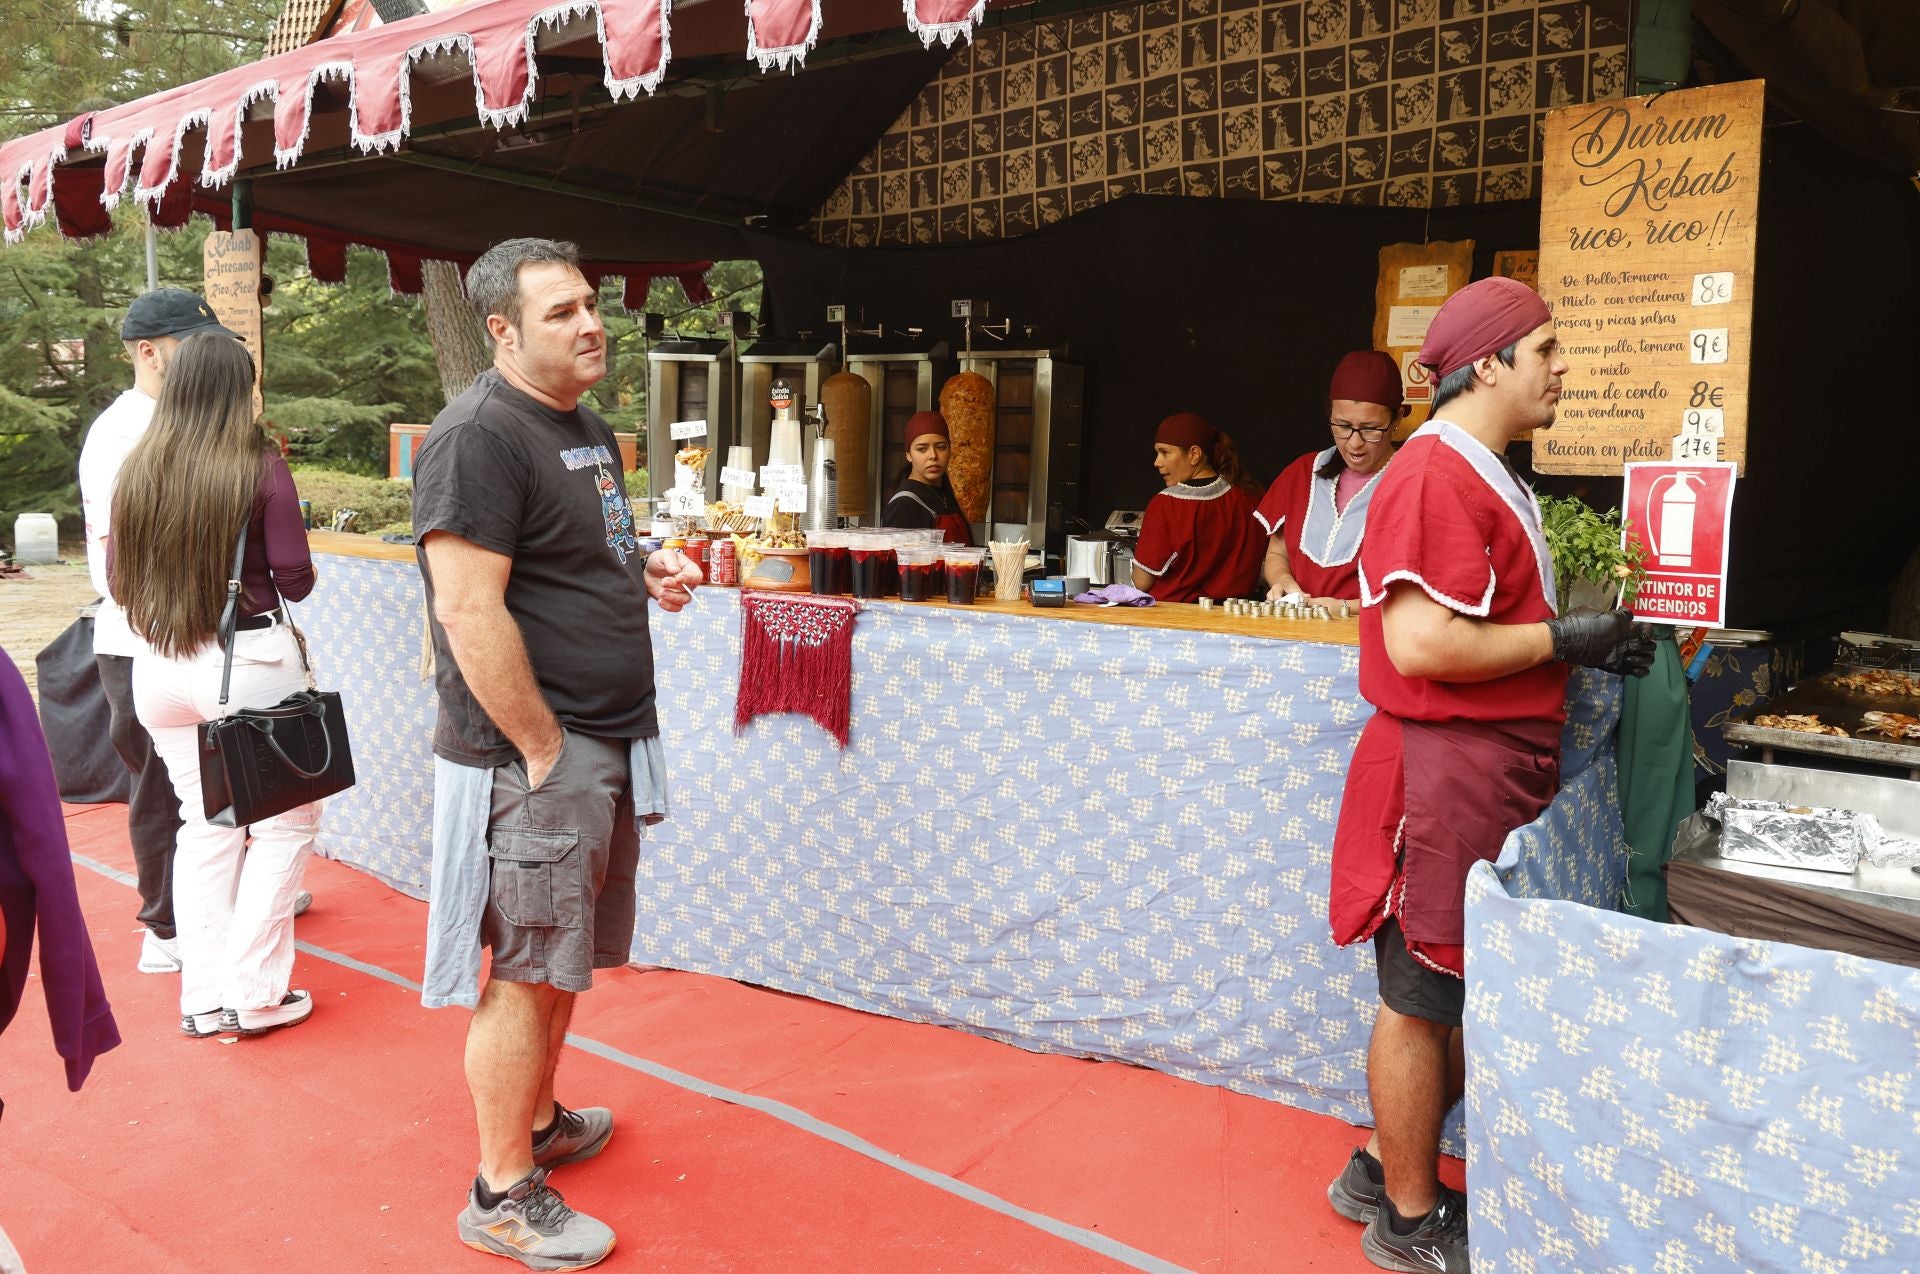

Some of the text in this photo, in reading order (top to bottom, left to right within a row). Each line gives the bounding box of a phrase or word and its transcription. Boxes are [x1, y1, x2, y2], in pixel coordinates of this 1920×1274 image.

[1568, 106, 1734, 167] Durum
[1579, 152, 1739, 217] Kebab
[1570, 209, 1735, 251] rico, rico!!
[207, 260, 254, 279] Artesano
[1560, 275, 1580, 287] De
[1701, 275, 1730, 303] 8€
[1558, 293, 1596, 307] Mixto
[1604, 296, 1625, 305] con
[1628, 289, 1687, 304] verduras
[1553, 311, 1677, 331] frescas y ricas salsas
[1569, 345, 1601, 355] carne
[1604, 339, 1637, 358] pollo,
[1639, 338, 1685, 352] ternera
[1600, 362, 1631, 376] mixto
[1558, 381, 1669, 400] urum de cerdo
[1689, 381, 1724, 408] 8€
[1564, 403, 1645, 420] con verduras
[1601, 444, 1620, 457] en
[1623, 439, 1664, 463] plato
[1680, 437, 1712, 458] 17€
[679, 496, 695, 510] 9€
[1636, 580, 1716, 598] XTINTOR DE
[1634, 597, 1707, 616] INCENDIOS
